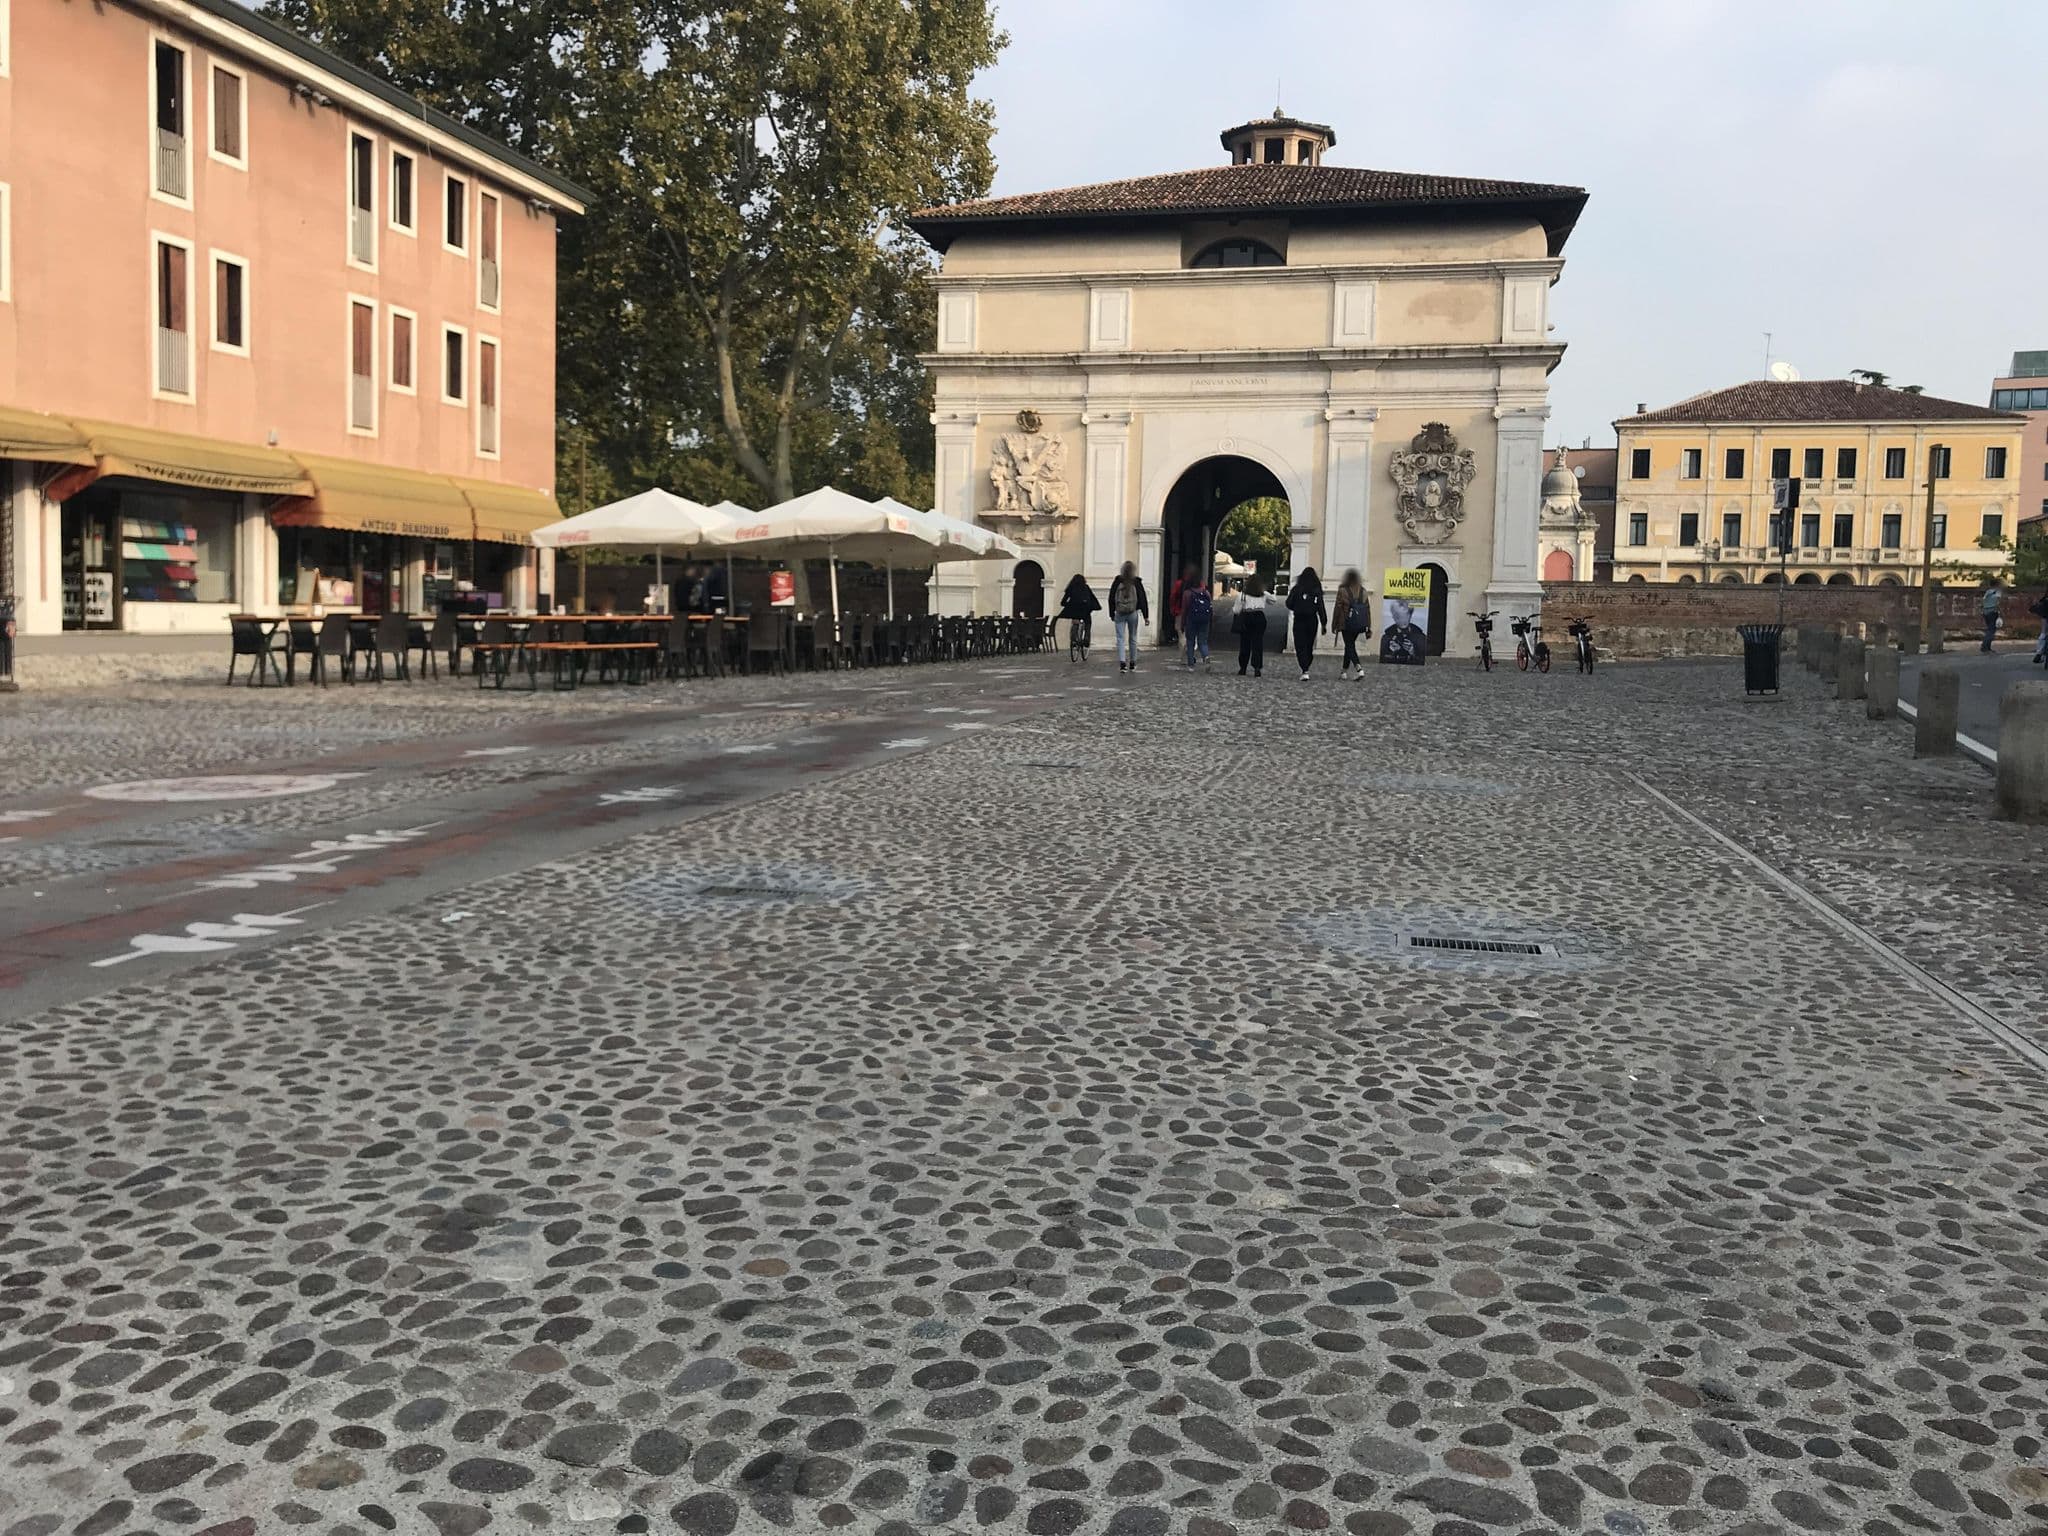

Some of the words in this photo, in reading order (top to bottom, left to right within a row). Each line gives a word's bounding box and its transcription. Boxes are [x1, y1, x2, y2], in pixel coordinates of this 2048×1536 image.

[360, 519, 398, 531] ANTICO
[402, 522, 450, 536] DESIDERIO
[735, 524, 769, 539] Coca-Cola
[1402, 571, 1426, 580] ANDY
[1389, 579, 1425, 588] WARHOL
